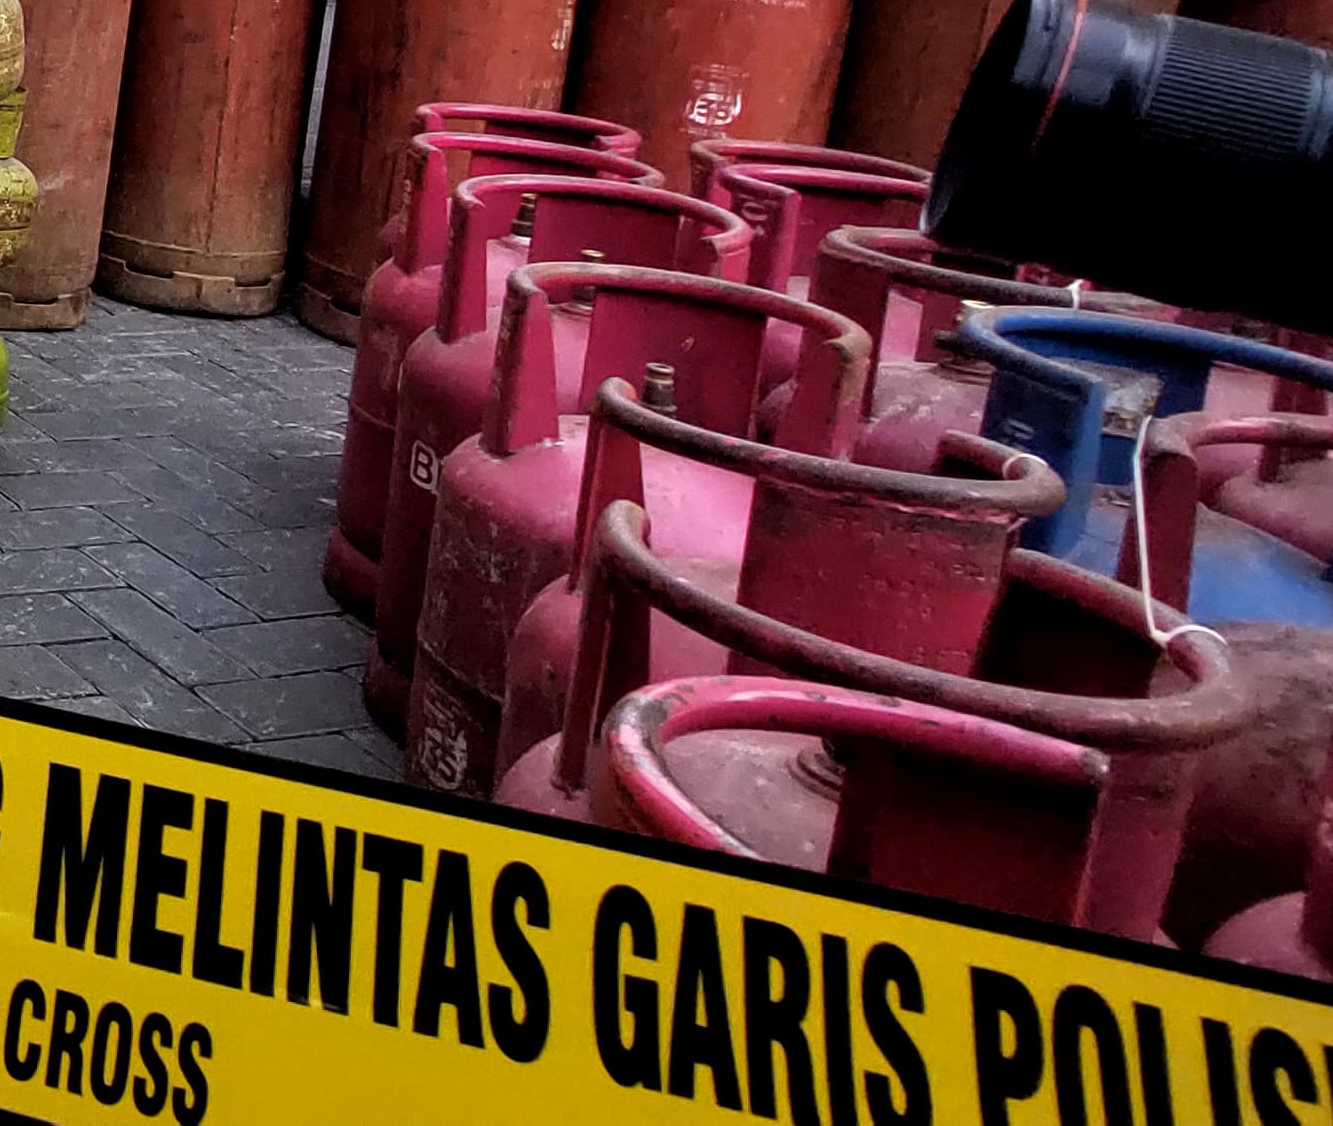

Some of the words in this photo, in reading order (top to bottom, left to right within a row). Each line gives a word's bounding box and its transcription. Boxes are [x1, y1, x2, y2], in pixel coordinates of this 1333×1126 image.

[3, 978, 214, 1126] CROSS
[33, 763, 551, 1065] MELINTAS
[593, 883, 935, 1126] GARIS
[970, 966, 1333, 1126] POLIS
